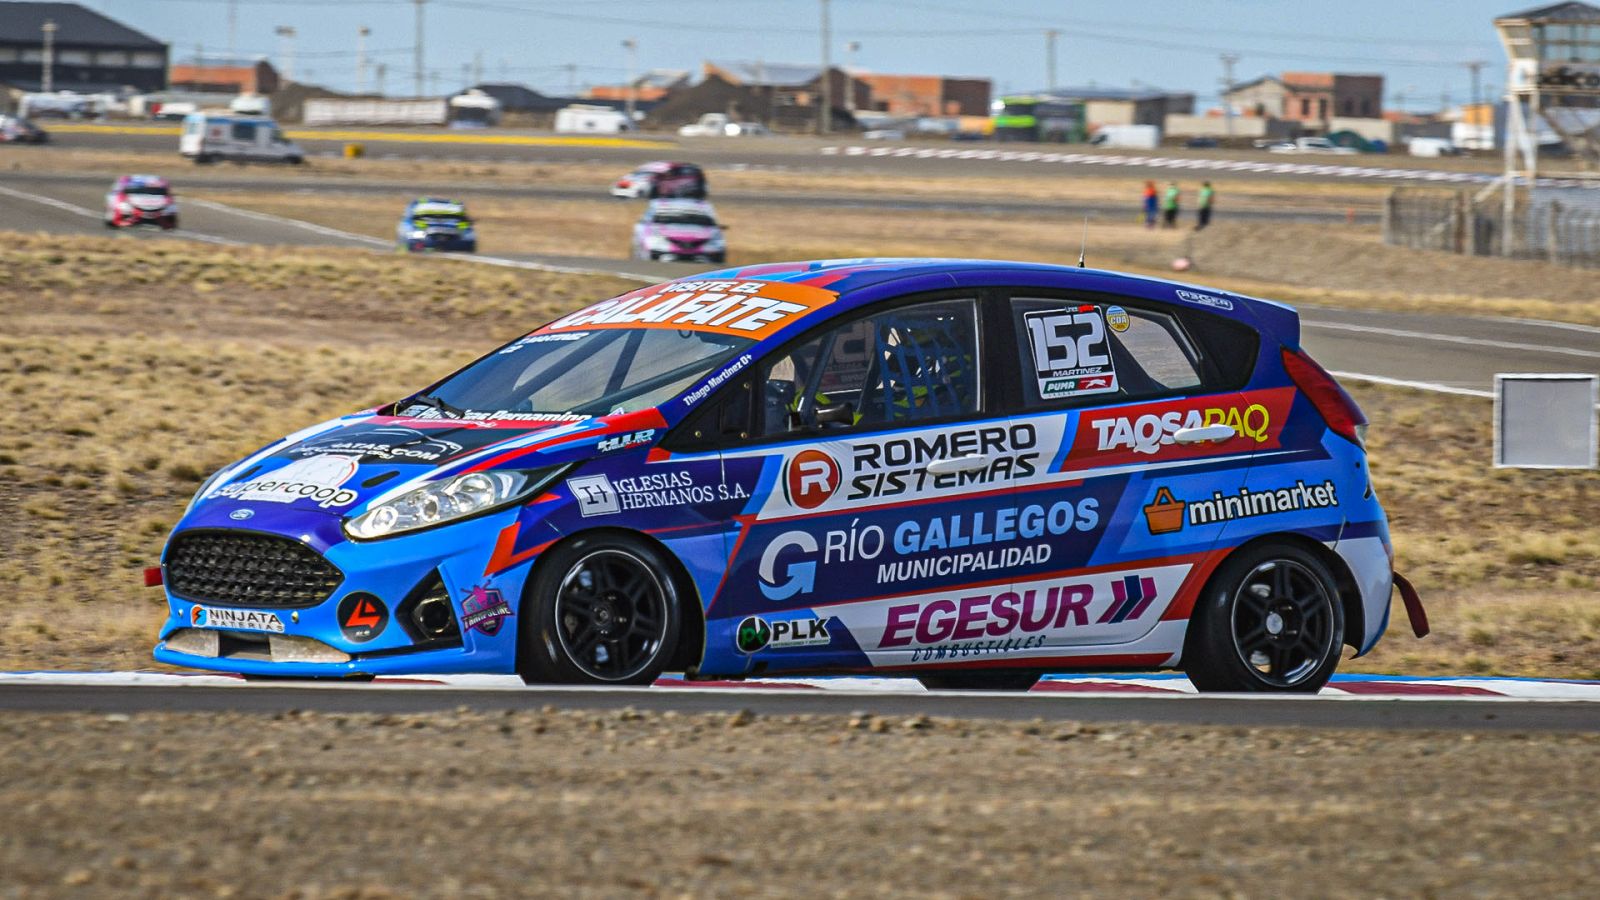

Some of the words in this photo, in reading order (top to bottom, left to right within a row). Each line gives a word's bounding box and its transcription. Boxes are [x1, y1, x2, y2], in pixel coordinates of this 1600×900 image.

[658, 281, 740, 293] VISITE
[727, 282, 767, 294] EL
[549, 292, 809, 331] CALAFATE
[1028, 312, 1109, 371] 152
[683, 384, 710, 406] Thiago
[708, 361, 743, 389] Martinez
[1047, 381, 1075, 391] PUMA
[1053, 366, 1102, 377] MARTINEZ
[853, 423, 1037, 472] ROMERO
[612, 471, 693, 493] IGLESIAS
[800, 459, 831, 496] R
[848, 452, 1040, 500] SISTEMAS
[621, 485, 714, 510] HERMANOS
[719, 482, 750, 501] S.A.
[1190, 482, 1338, 524] minimarket
[824, 518, 884, 564] RÍO
[893, 498, 1099, 554] GALLEGOS
[877, 543, 1051, 583] MUNICIPALIDAD
[209, 609, 281, 625] NINJATA
[210, 620, 284, 632] BATERIAS
[772, 619, 829, 641] PLK
[878, 583, 1094, 648] EGESUR
[911, 634, 1047, 662] COMBUSTIBLES
